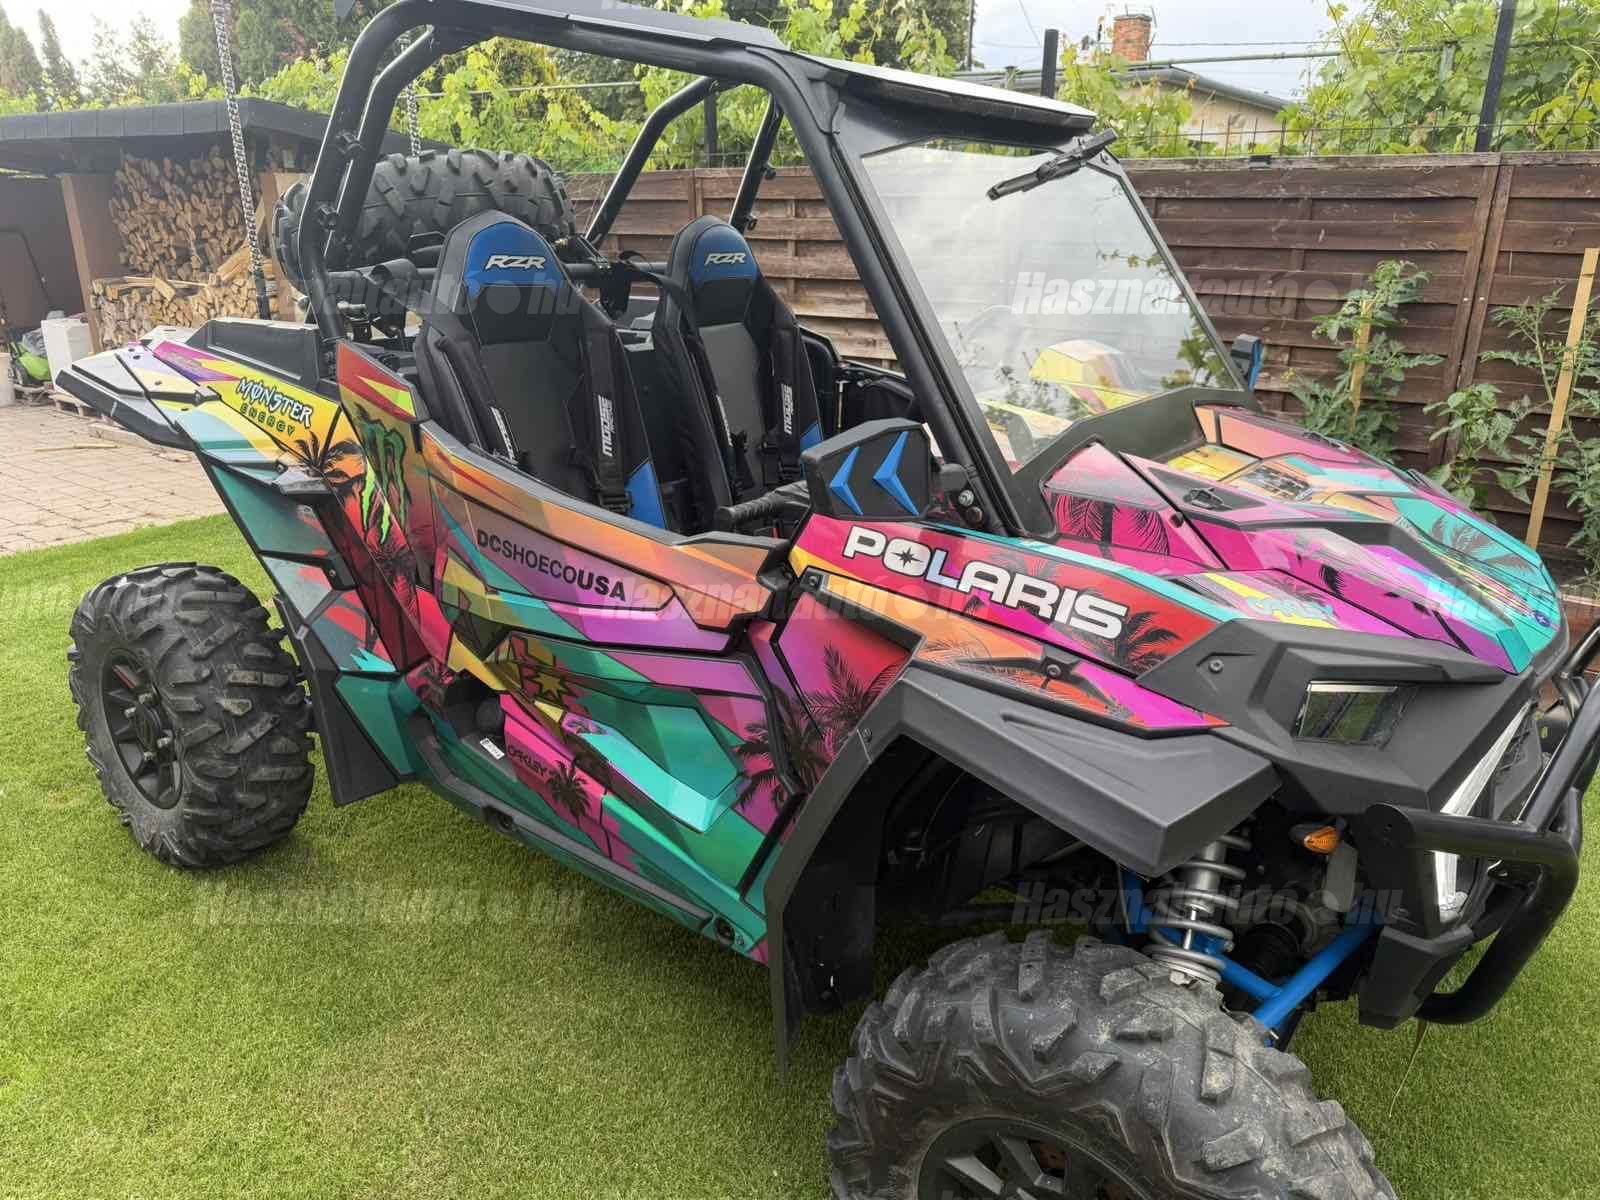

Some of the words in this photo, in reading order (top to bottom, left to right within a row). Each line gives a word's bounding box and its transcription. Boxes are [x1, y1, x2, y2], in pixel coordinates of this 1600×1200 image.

[484, 254, 546, 271] RZR
[704, 252, 746, 266] RZR
[239, 402, 296, 437] ENERGY
[476, 529, 627, 601] DCSHOECOUSA
[842, 526, 1129, 640] POLARIS
